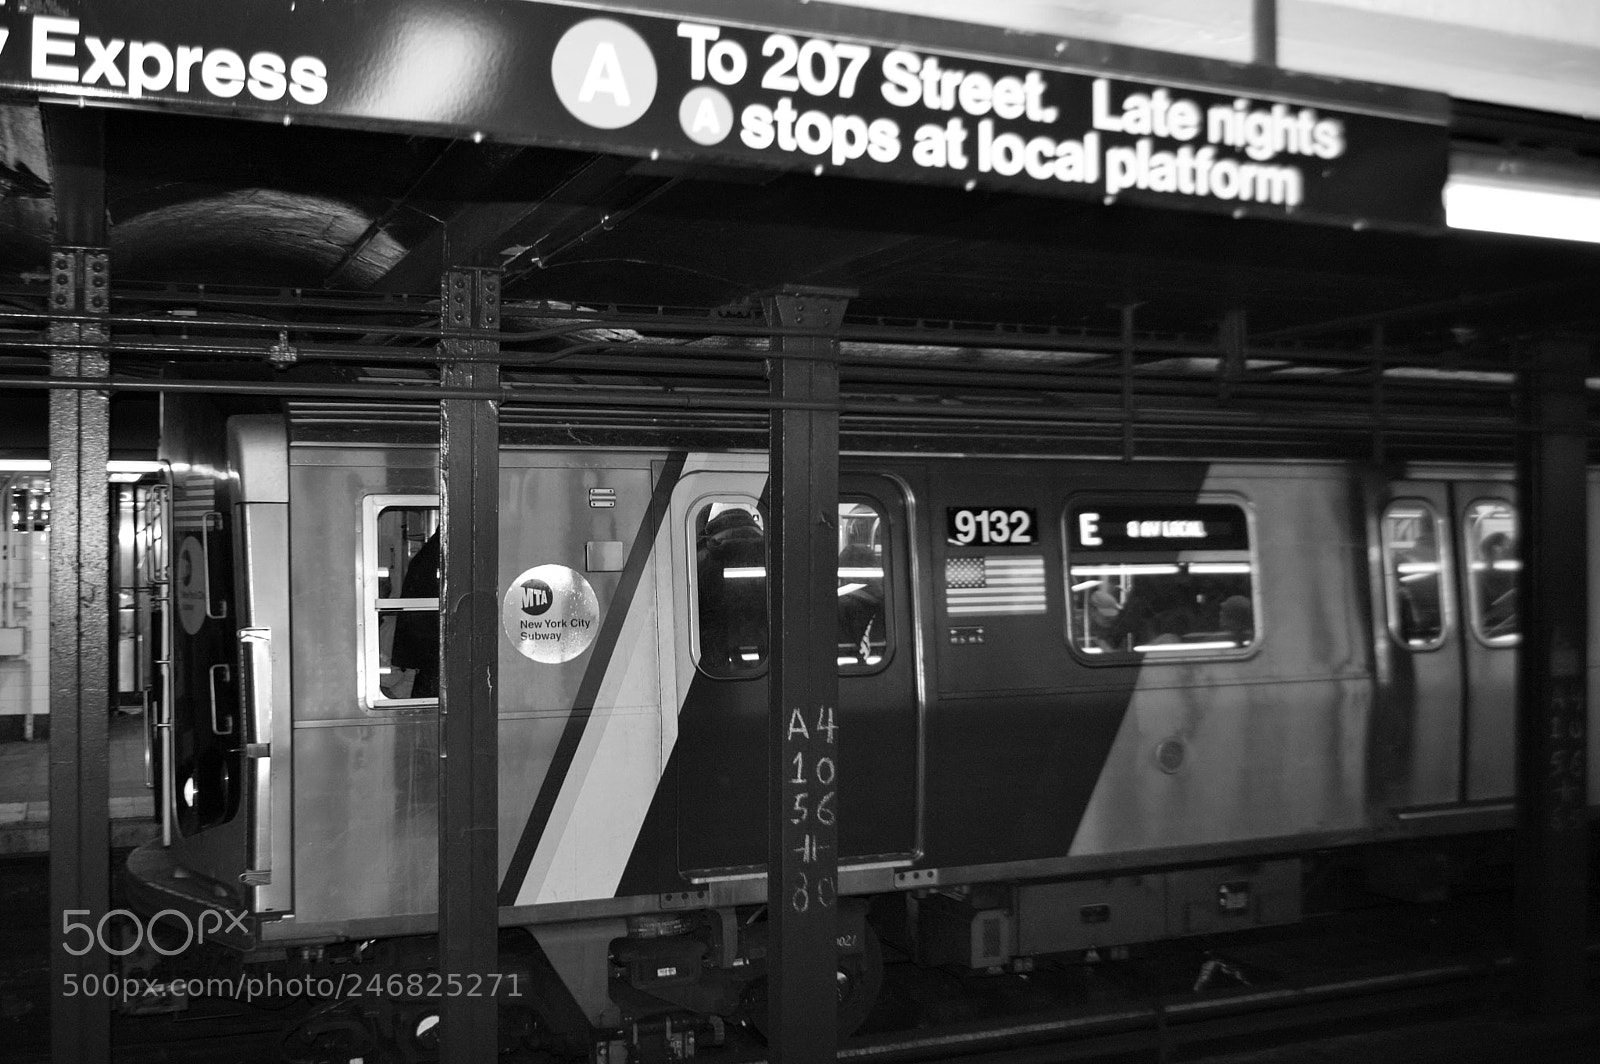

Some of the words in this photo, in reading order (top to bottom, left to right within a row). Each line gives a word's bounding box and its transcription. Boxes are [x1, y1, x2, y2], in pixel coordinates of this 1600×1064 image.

[32, 15, 328, 106] Express
[577, 42, 631, 107] A
[677, 22, 748, 86] To
[761, 33, 871, 98] 207
[880, 49, 1058, 124] Street.
[1092, 78, 1201, 142] Late
[1207, 98, 1344, 162] nights
[691, 97, 721, 136] A
[739, 97, 901, 166] stops
[912, 117, 968, 170] at
[977, 118, 1099, 184] local
[1105, 138, 1301, 207] platform
[955, 510, 1031, 543] 9132
[1079, 513, 1103, 545] E
[521, 587, 548, 609] MTA
[520, 619, 542, 629] New
[544, 619, 567, 628] York
[570, 618, 591, 629] City
[520, 631, 562, 641] Subway
